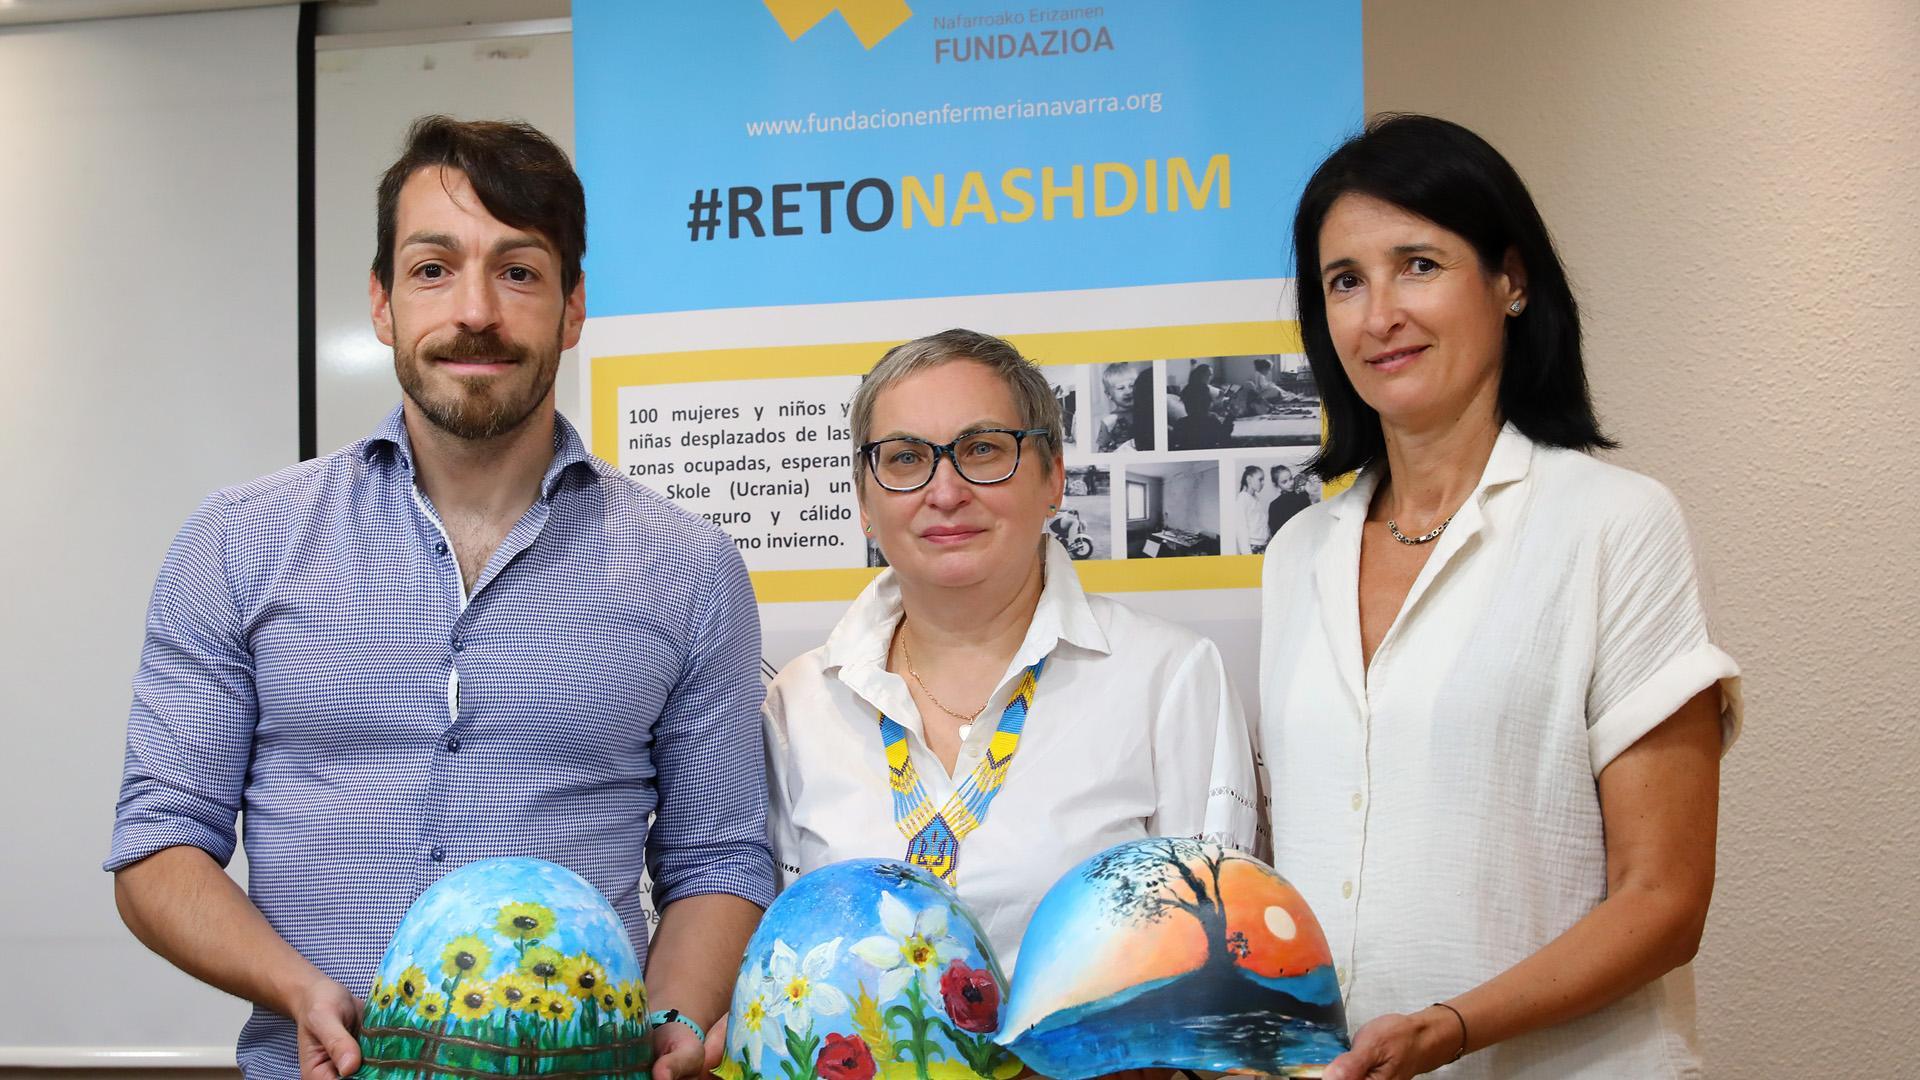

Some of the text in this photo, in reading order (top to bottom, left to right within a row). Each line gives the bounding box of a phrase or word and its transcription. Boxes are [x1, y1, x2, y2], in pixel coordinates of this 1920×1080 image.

[933, 6, 1105, 30] Nafarroako Erizainen
[935, 26, 1114, 64] FUNDAZIOA
[747, 93, 1162, 136] www.fundacionenfermerianavarra.org
[687, 154, 1231, 242] #RETONASHDIM
[630, 400, 851, 424] 100 mujeres y niños y
[630, 425, 850, 449] niñas desplazados de las
[630, 453, 851, 476] zonas ocupadas, esperan
[667, 479, 850, 500] Skole (Ucrania) un
[701, 505, 851, 526] eguro y cálido
[768, 533, 844, 548] invierno.
